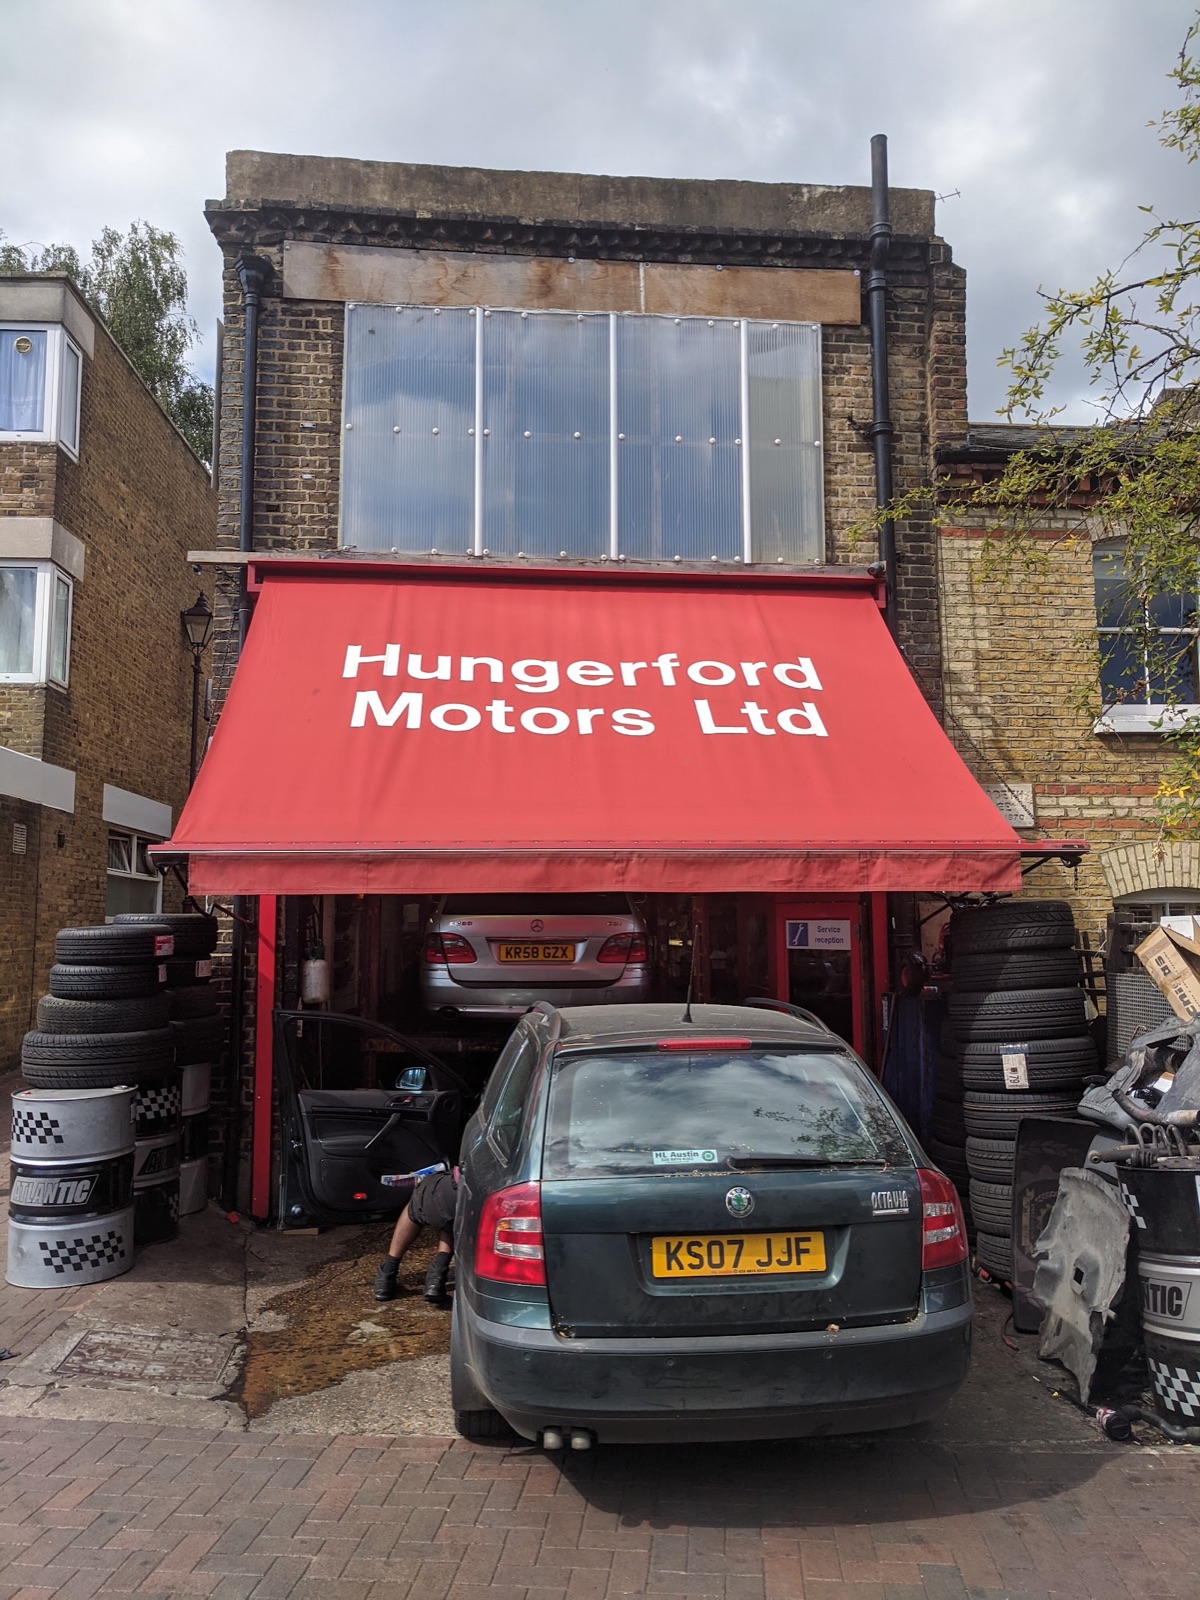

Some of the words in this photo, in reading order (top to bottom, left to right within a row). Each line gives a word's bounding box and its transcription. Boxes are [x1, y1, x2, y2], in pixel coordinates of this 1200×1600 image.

[342, 643, 823, 693] Hungerford
[350, 690, 656, 736] Motors
[693, 699, 829, 737] Ltd
[814, 936, 844, 944] reception
[816, 925, 841, 933] Service
[505, 947, 540, 959] KR58
[543, 947, 569, 959] GZX
[13, 1179, 91, 1204] ATLANTIC
[871, 1190, 909, 1209] OCTAVIA
[665, 1239, 745, 1271] KS07
[755, 1237, 812, 1268] JJF
